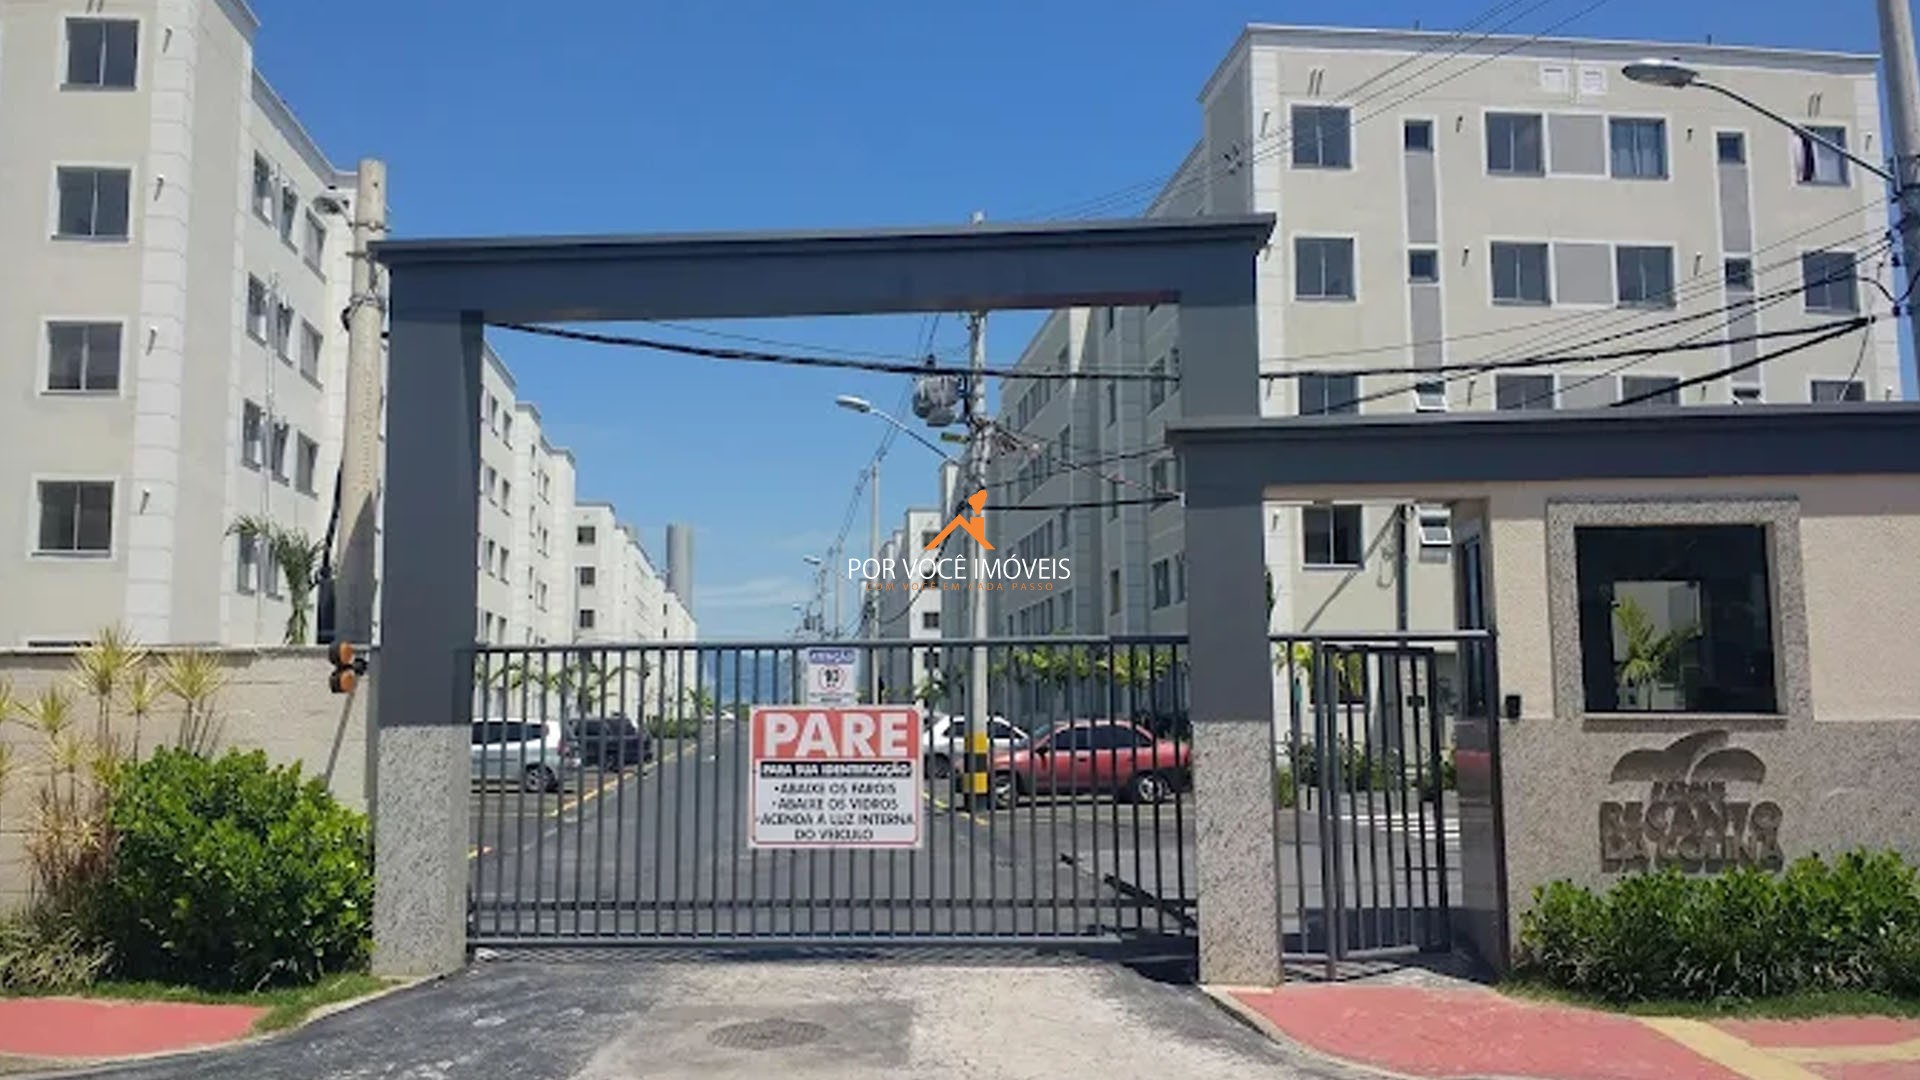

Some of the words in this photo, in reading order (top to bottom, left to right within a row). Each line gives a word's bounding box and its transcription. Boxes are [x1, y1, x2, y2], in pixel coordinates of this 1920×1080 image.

[763, 713, 908, 757] PARE
[762, 763, 792, 776] PARA
[780, 783, 825, 795] ABAIXE
[829, 783, 847, 795] OS
[778, 798, 824, 810] ABAIXE
[828, 798, 847, 810] OS
[849, 798, 899, 810] VIDROS
[760, 813, 814, 826] ACENDA
[817, 813, 829, 826] A
[831, 813, 855, 826] LUZ
[858, 813, 914, 826] INTERNA
[794, 829, 816, 841] DO
